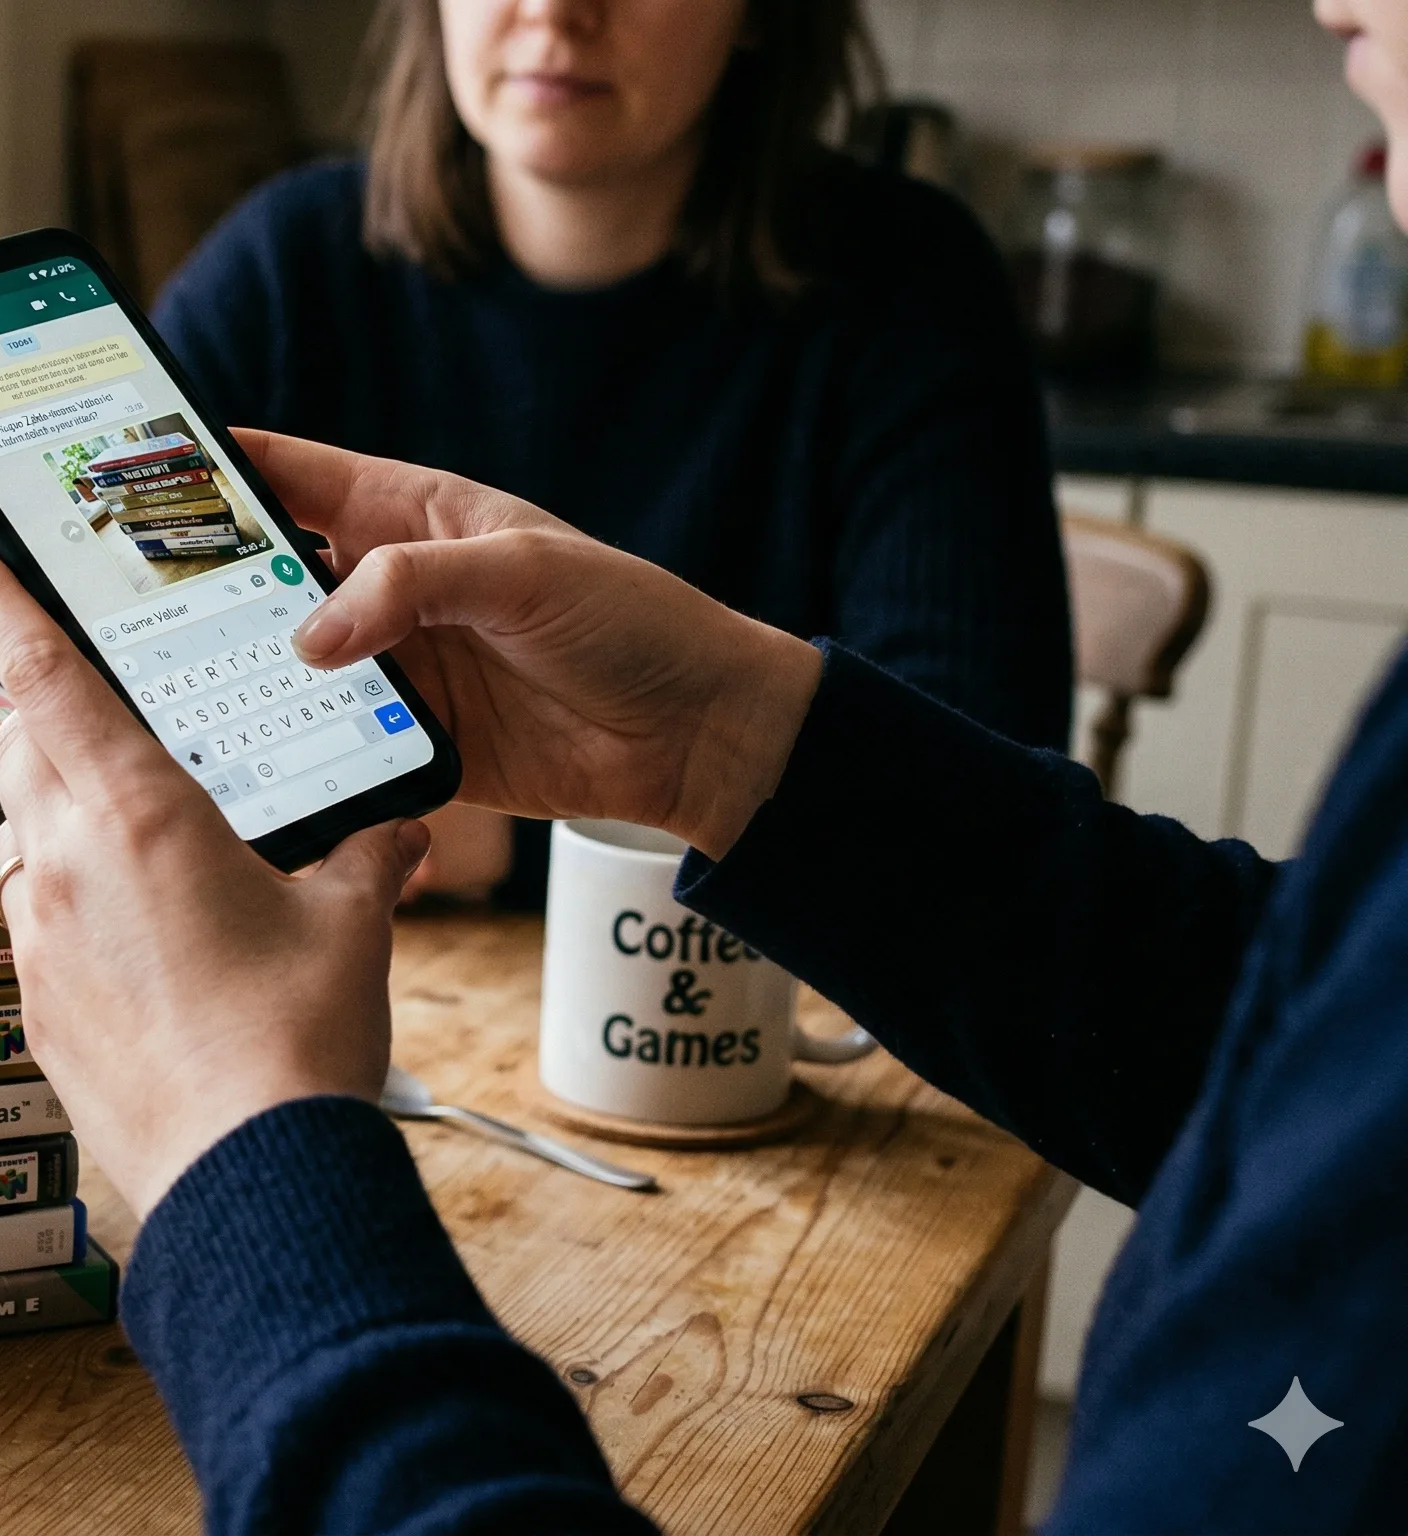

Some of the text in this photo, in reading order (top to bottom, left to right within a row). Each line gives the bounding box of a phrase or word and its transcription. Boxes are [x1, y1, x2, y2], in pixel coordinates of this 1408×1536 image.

[120, 617, 155, 634] Game
[141, 642, 282, 704] Q W E R T Y U
[176, 669, 314, 732] A S D F G H J
[216, 690, 356, 755] Z X C V B N M
[662, 969, 712, 1016] &
[602, 1013, 761, 1067] Games
